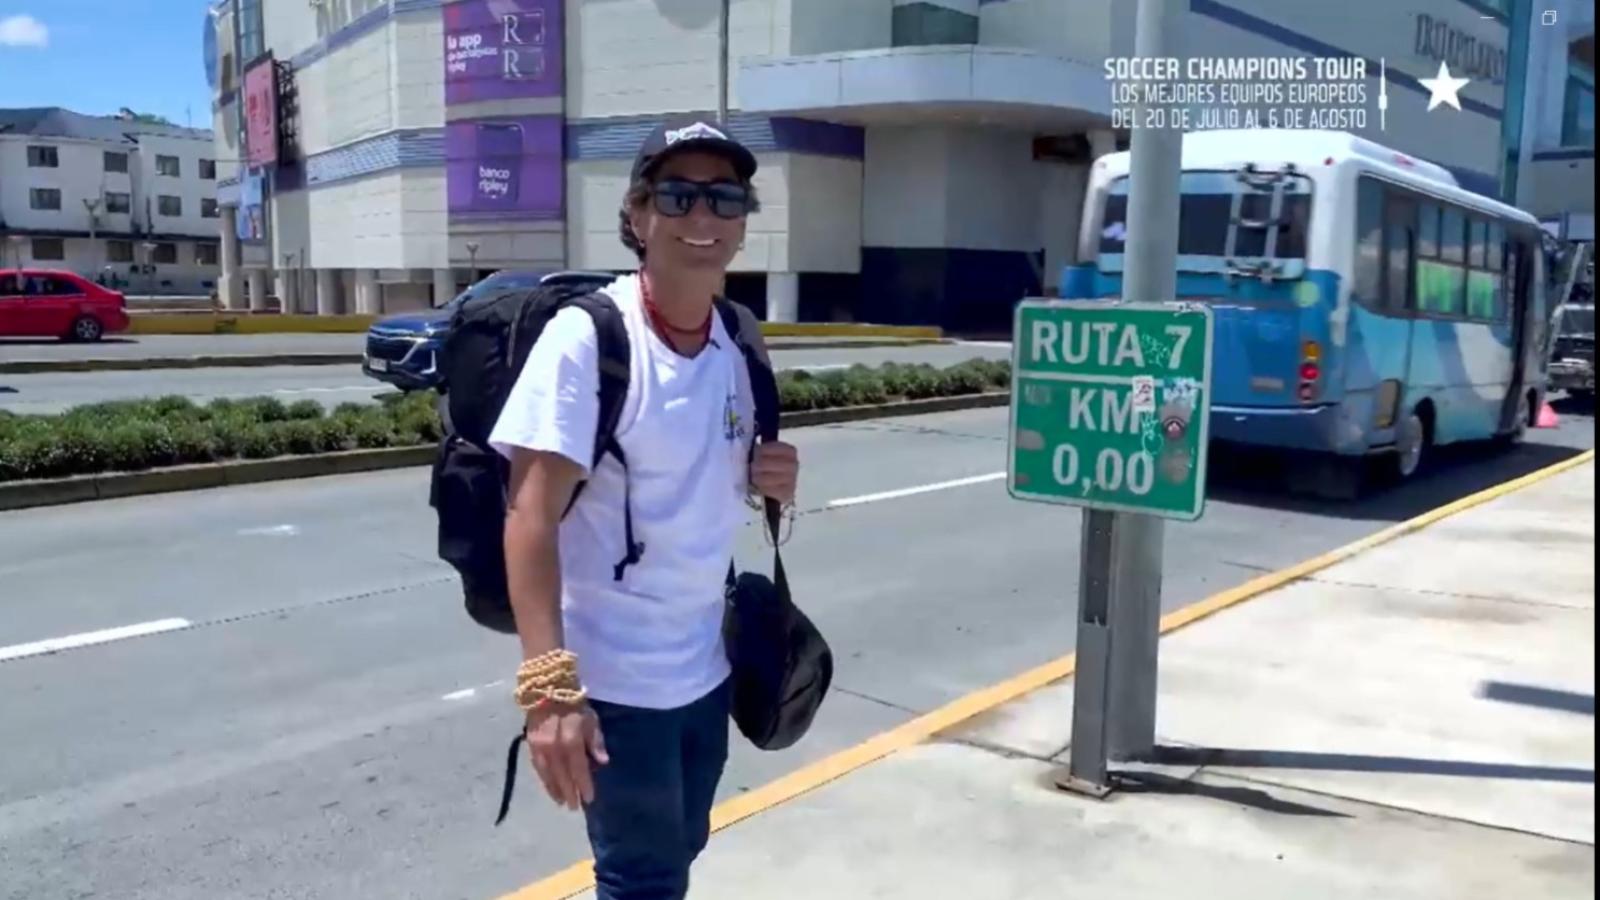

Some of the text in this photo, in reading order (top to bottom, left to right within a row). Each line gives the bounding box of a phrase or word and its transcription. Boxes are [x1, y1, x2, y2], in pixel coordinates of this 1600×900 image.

[459, 34, 482, 50] app
[503, 14, 523, 44] R
[503, 49, 522, 78] R
[479, 166, 511, 179] banco
[479, 179, 509, 195] ripley
[1031, 319, 1193, 370] RUTA 7
[1068, 386, 1144, 434] KM
[1051, 443, 1155, 496] 0,00
